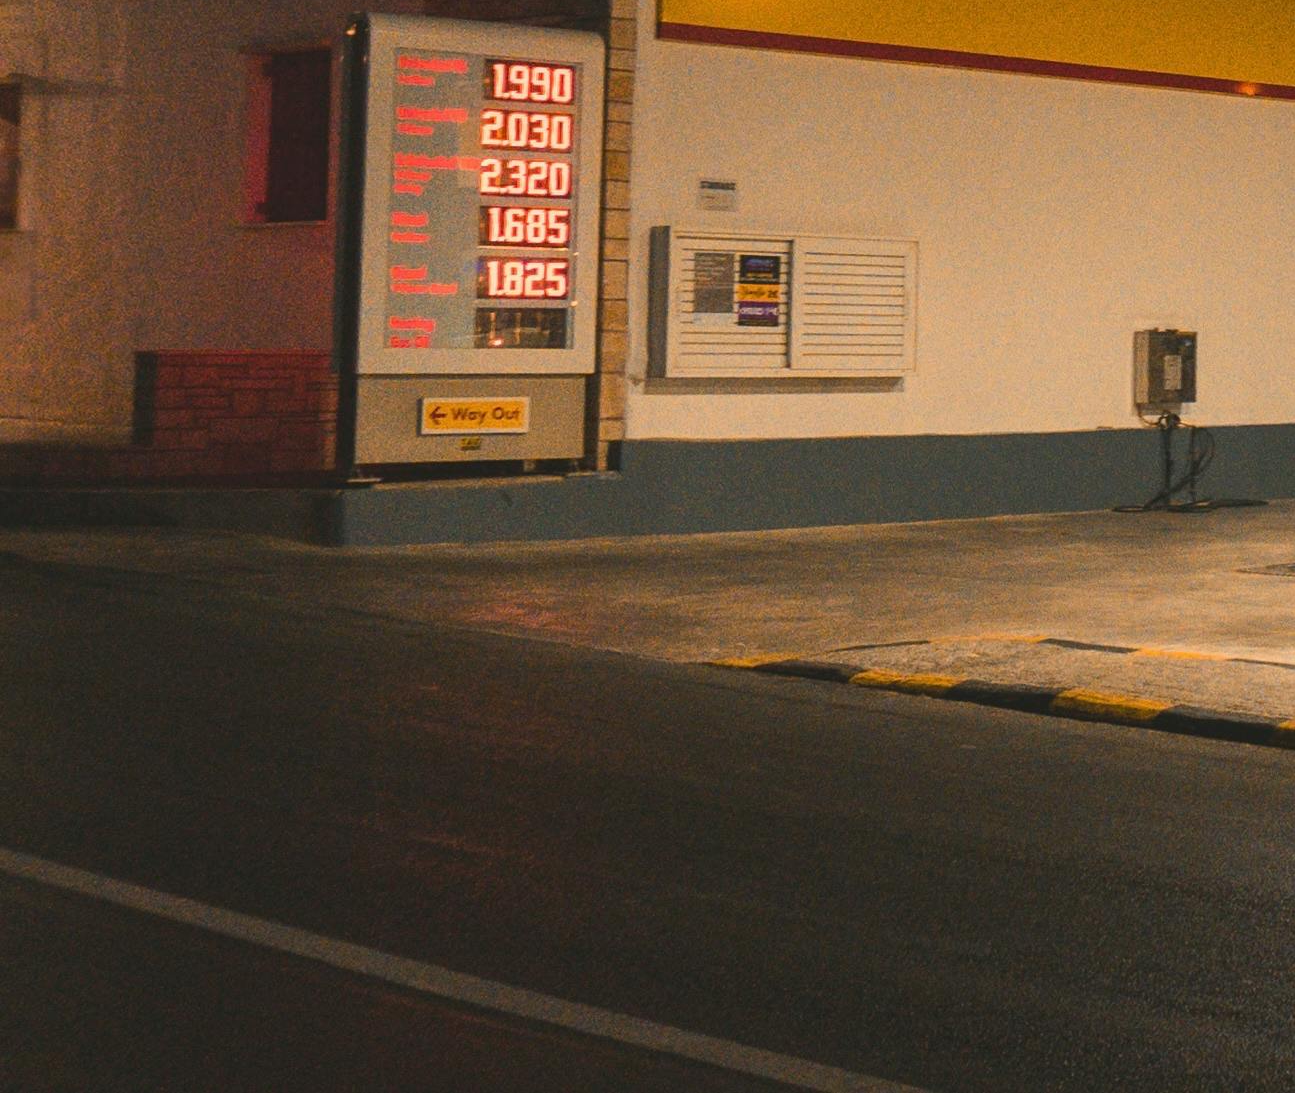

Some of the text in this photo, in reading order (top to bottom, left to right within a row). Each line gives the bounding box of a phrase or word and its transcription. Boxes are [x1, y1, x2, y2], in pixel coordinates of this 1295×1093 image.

[493, 62, 573, 103] 1.990
[480, 110, 572, 151] 2.030
[480, 158, 571, 197] 2.320
[489, 208, 569, 246] 1.685
[487, 261, 567, 299] 1.825
[451, 406, 520, 424] Way Out
